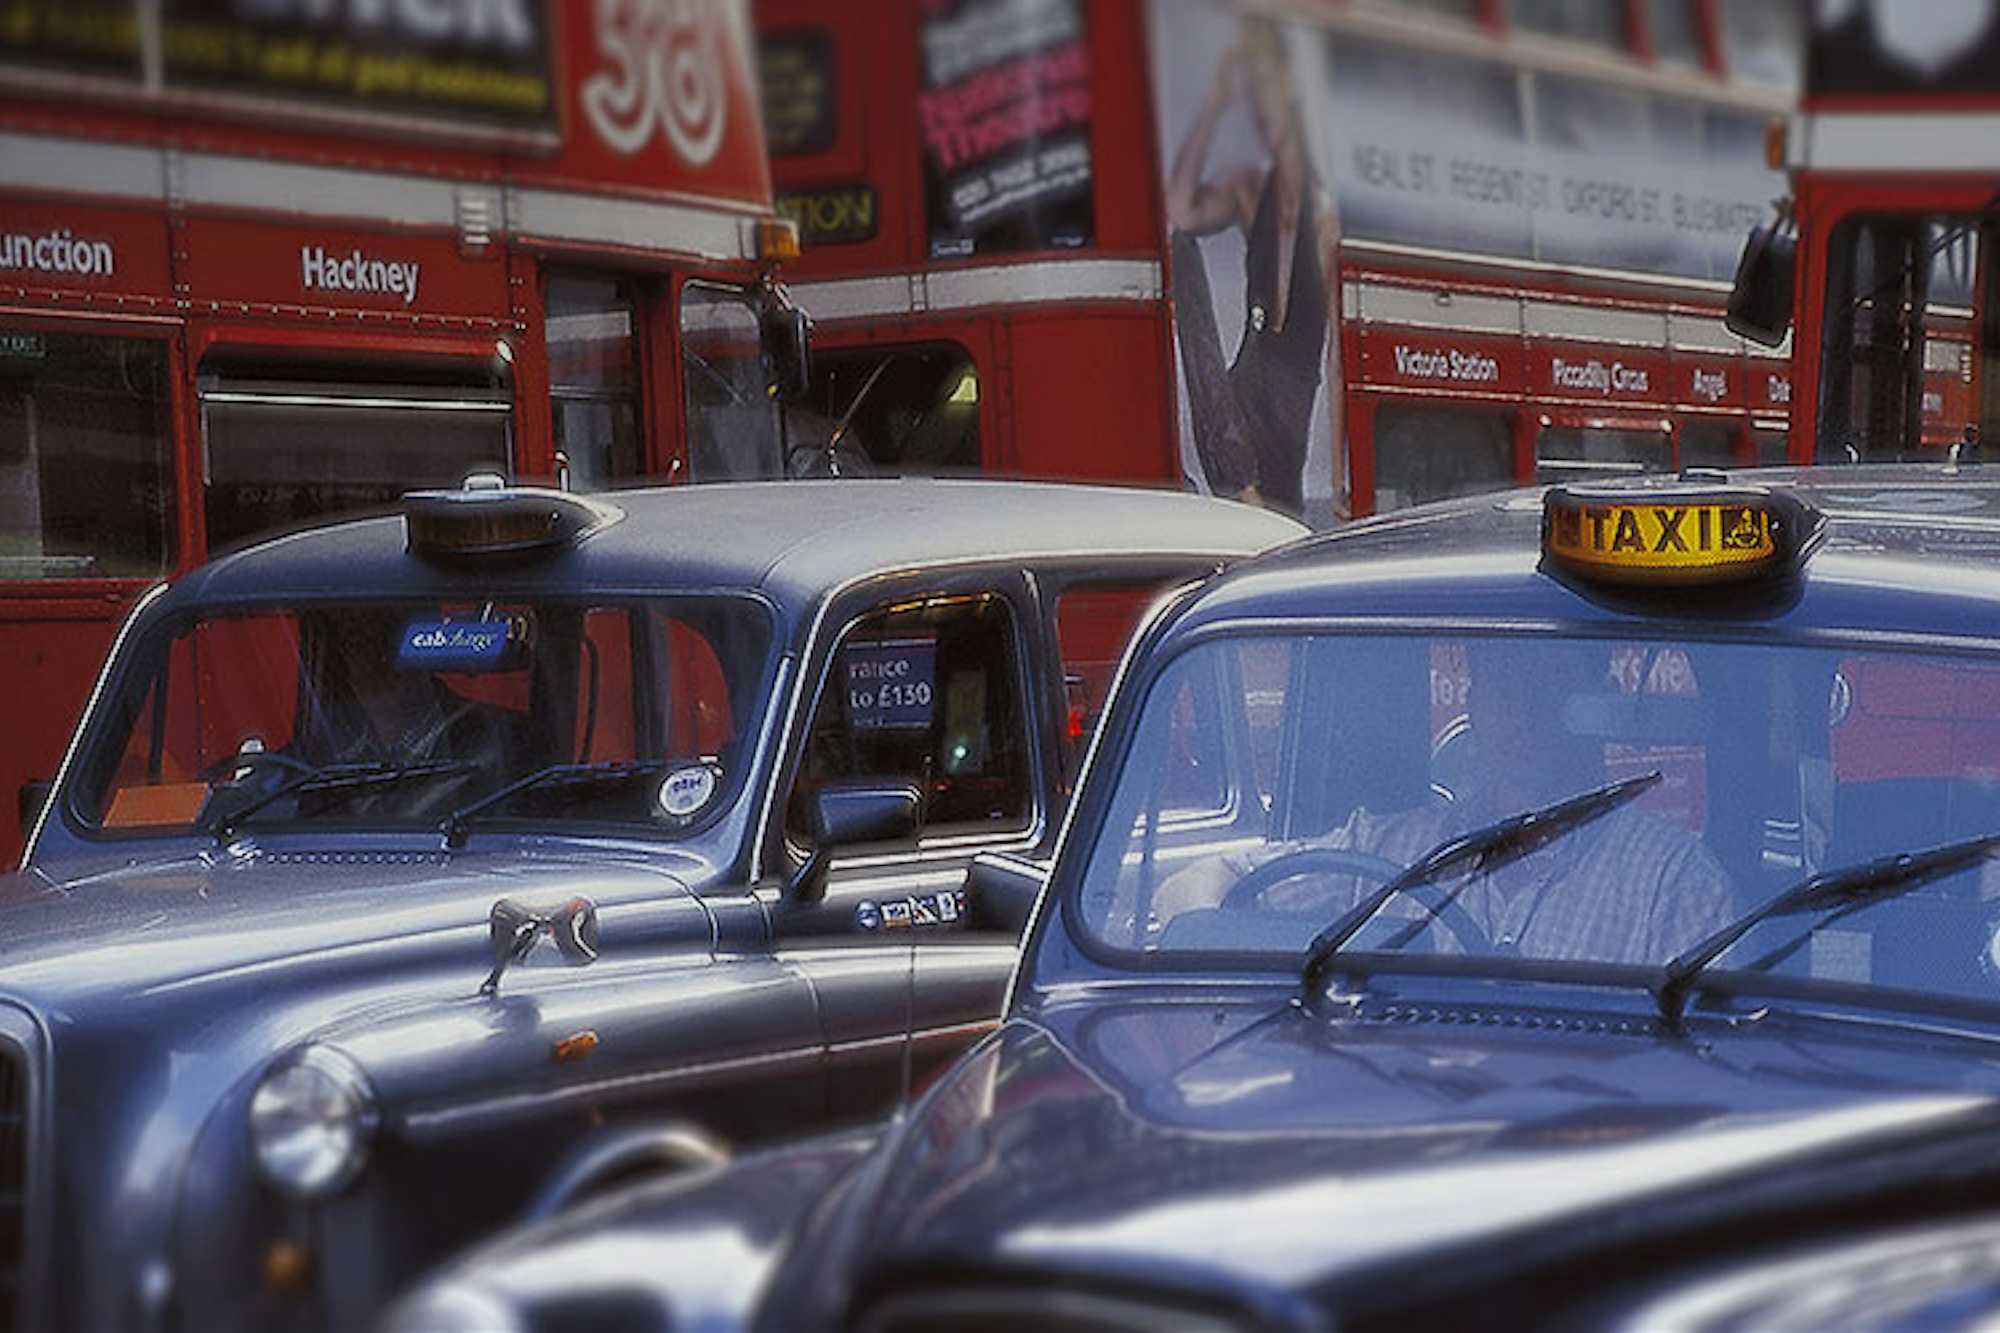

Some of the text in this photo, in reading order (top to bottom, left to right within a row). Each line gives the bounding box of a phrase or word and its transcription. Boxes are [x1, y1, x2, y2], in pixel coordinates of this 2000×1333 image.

[0, 228, 114, 275] unction
[302, 246, 418, 303] Hackney
[1395, 345, 1499, 381] Victoria Station
[1552, 358, 1649, 396] Piccadilly Circus
[1586, 508, 1712, 553] TAXI
[850, 680, 933, 710] to £130
